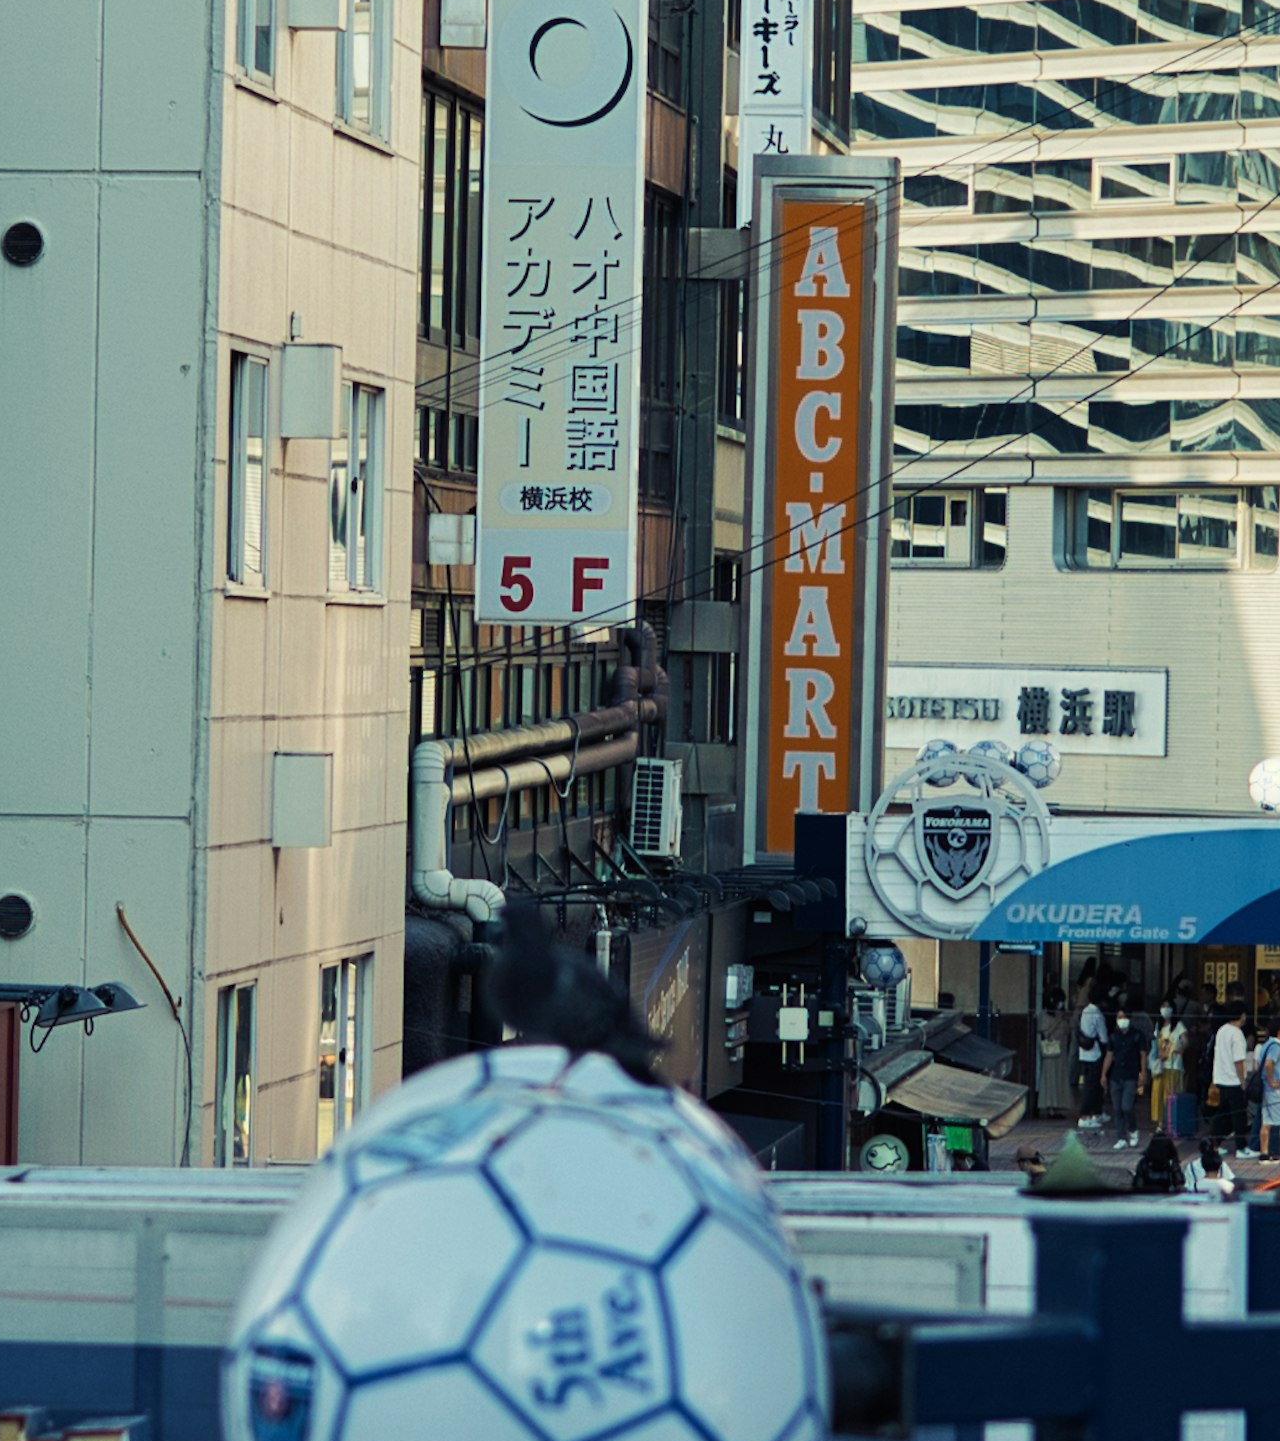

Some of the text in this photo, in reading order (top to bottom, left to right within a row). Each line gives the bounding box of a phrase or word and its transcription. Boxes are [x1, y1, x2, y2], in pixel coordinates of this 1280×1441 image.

[503, 196, 556, 468] アカデミー
[567, 196, 623, 472] ハオ中国語
[519, 486, 594, 513] 横浜校
[1016, 686, 1138, 738] 横浜駅
[924, 815, 990, 829] YOKOHAMA
[1006, 903, 1143, 926] OKUDERA
[1057, 916, 1198, 940] Frontier Gate 5
